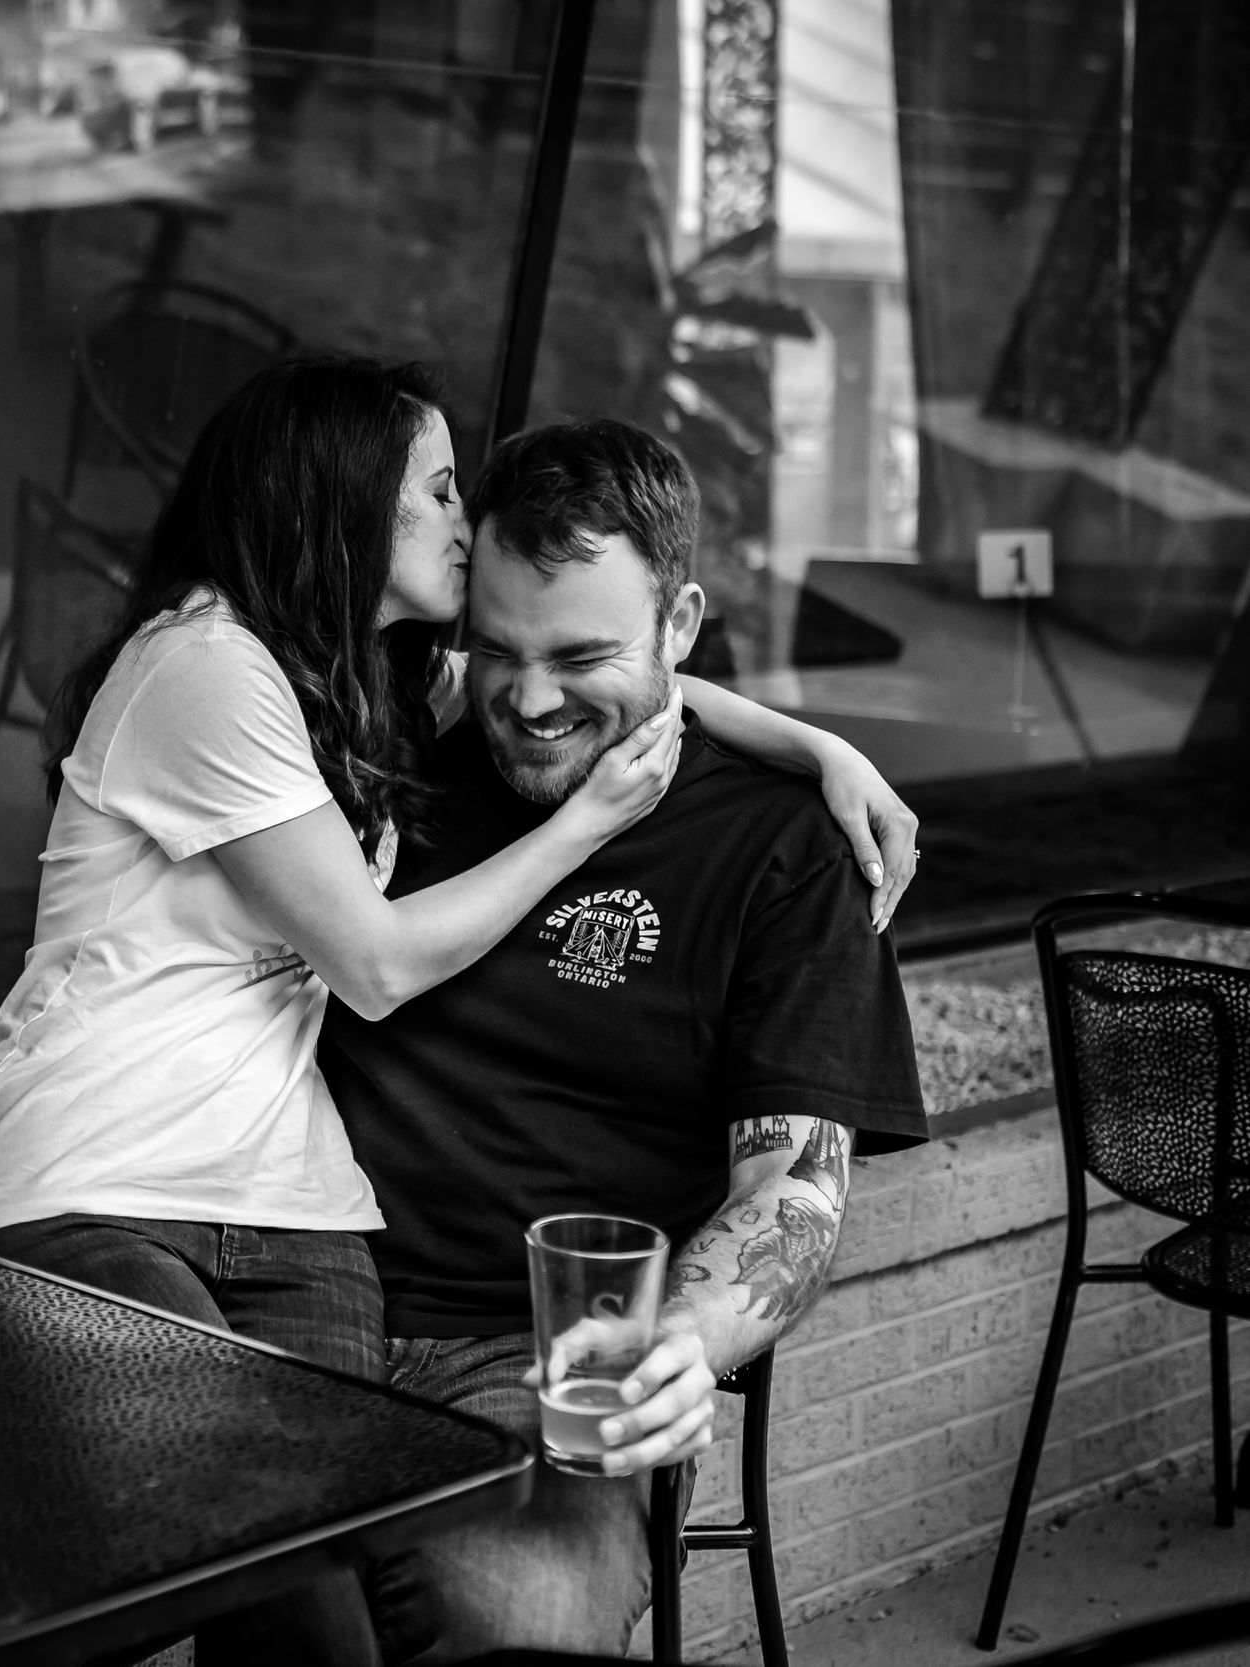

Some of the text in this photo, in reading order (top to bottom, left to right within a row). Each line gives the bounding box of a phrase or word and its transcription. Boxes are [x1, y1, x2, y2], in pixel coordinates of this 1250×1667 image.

[1006, 542, 1027, 584] 1
[546, 889, 660, 951] SILVERSTEIN
[582, 911, 629, 930] MISERY
[538, 930, 559, 942] EST.
[629, 953, 653, 964] 2000
[548, 959, 627, 983] BURLINGTON
[557, 970, 610, 988] ONTARIO
